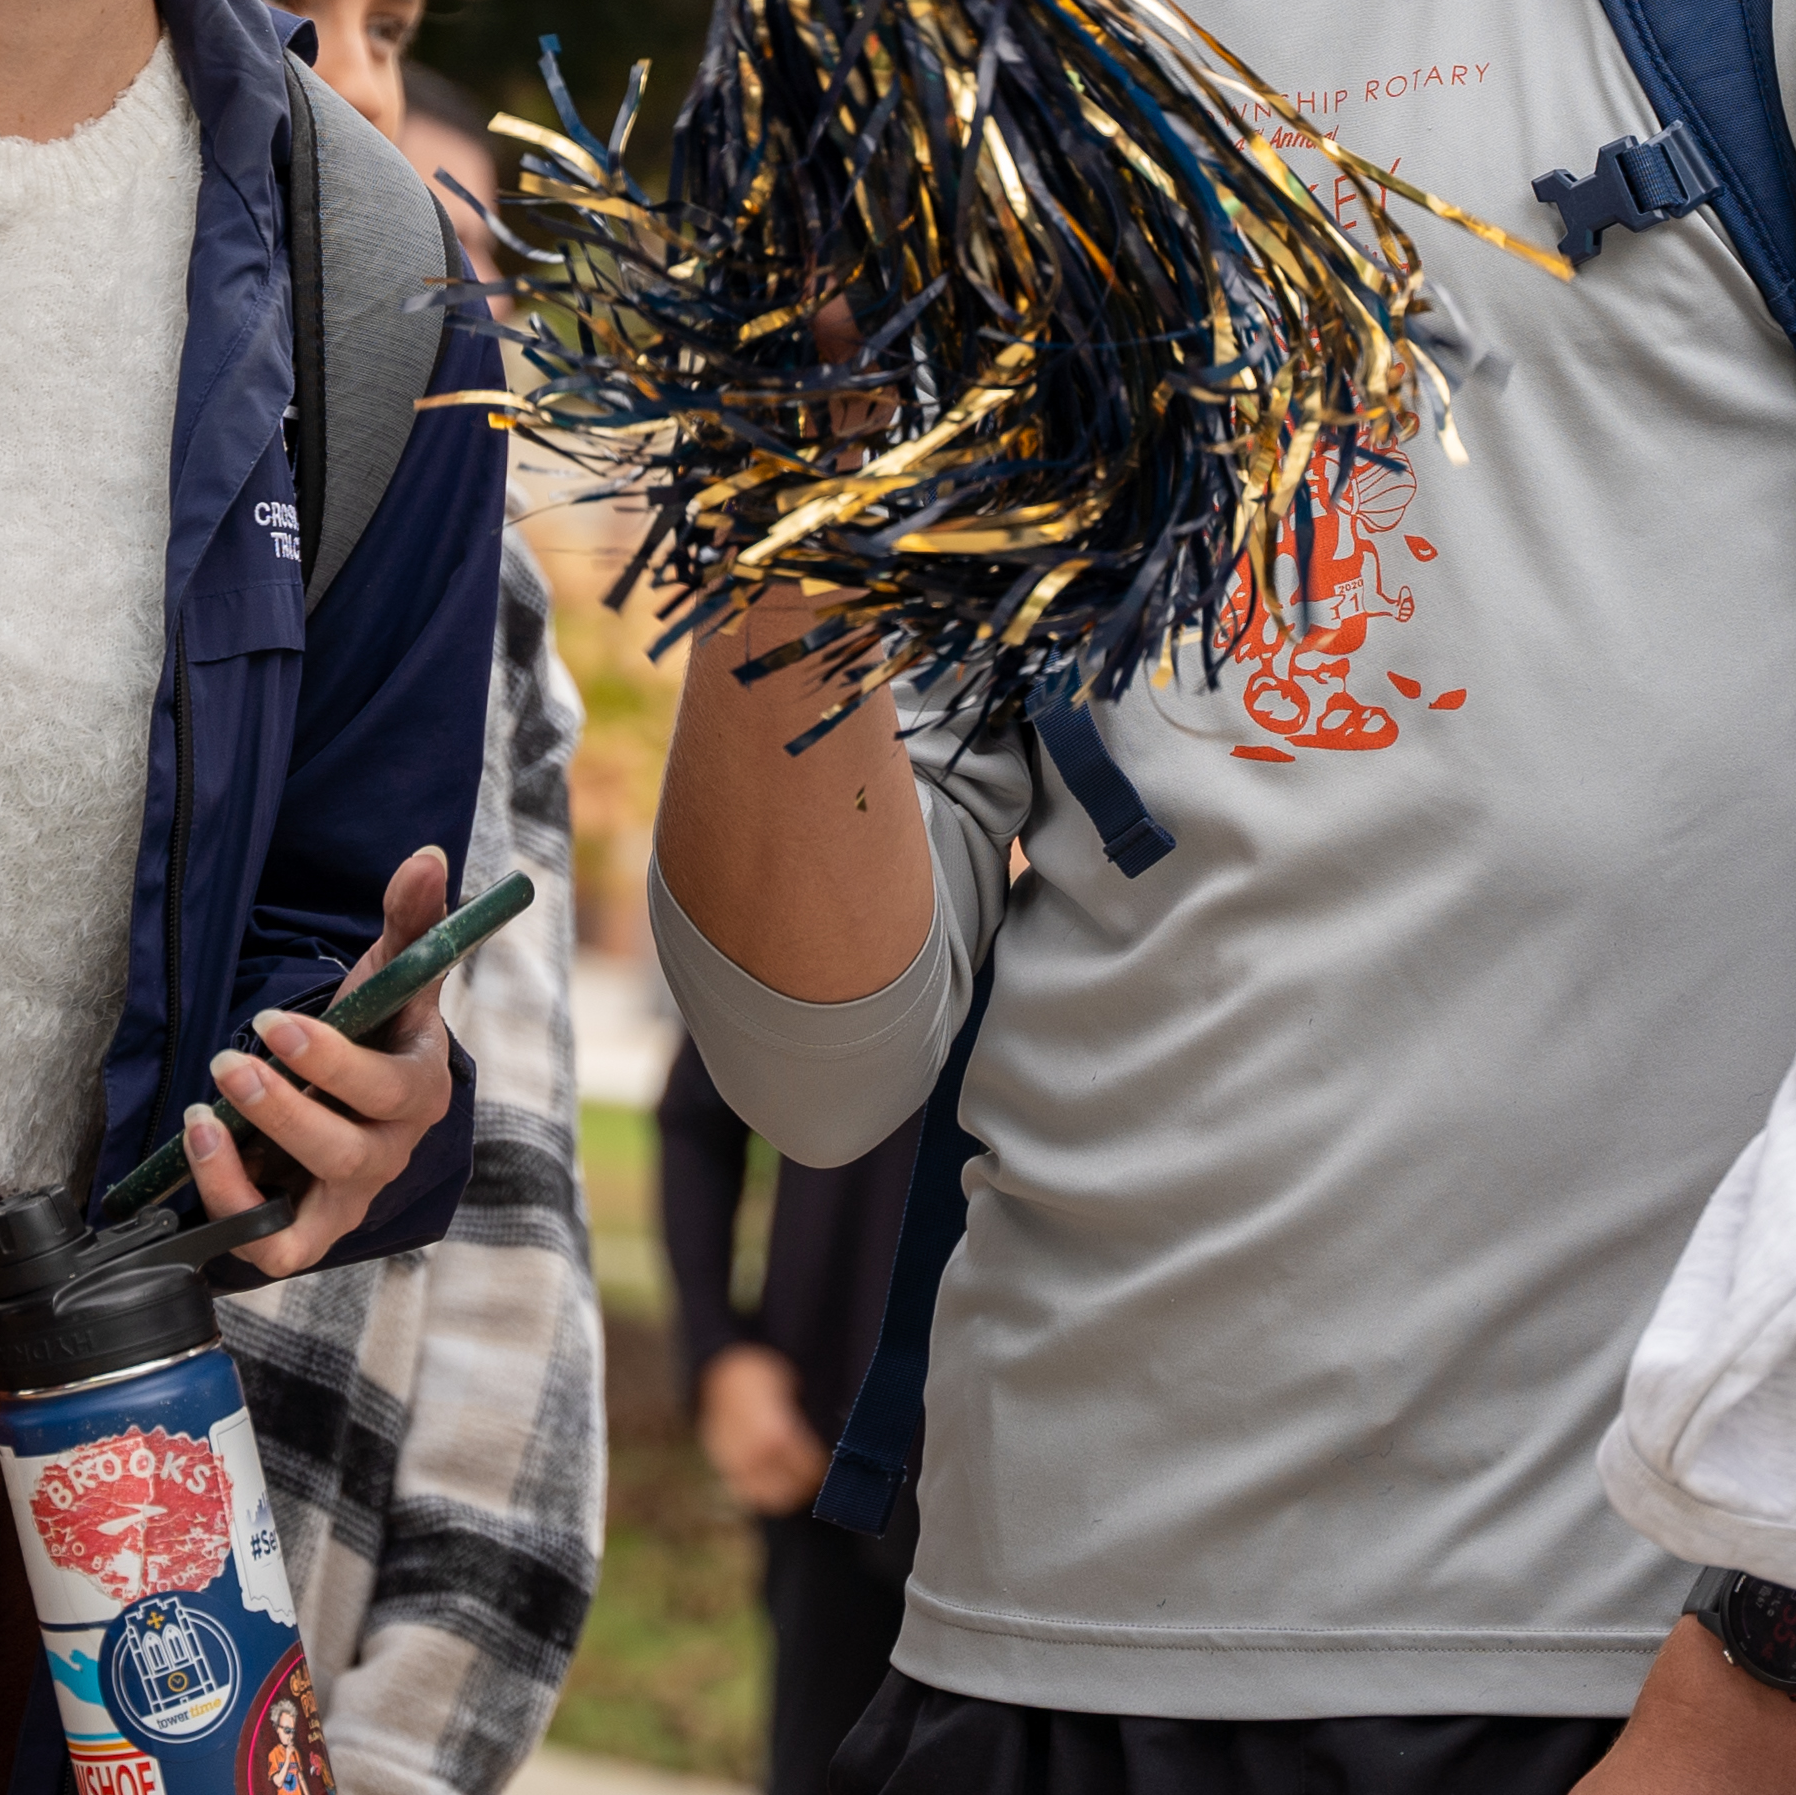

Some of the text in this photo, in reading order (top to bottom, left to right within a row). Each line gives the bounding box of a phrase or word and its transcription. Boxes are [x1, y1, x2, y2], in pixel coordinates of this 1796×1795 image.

[1365, 62, 1491, 102] ROTARY
[254, 501, 301, 532] CROS
[270, 532, 302, 562] TRAC
[1338, 578, 1364, 594] 2020
[47, 1447, 212, 1511] BROOKS
[250, 1529, 279, 1562] #Se
